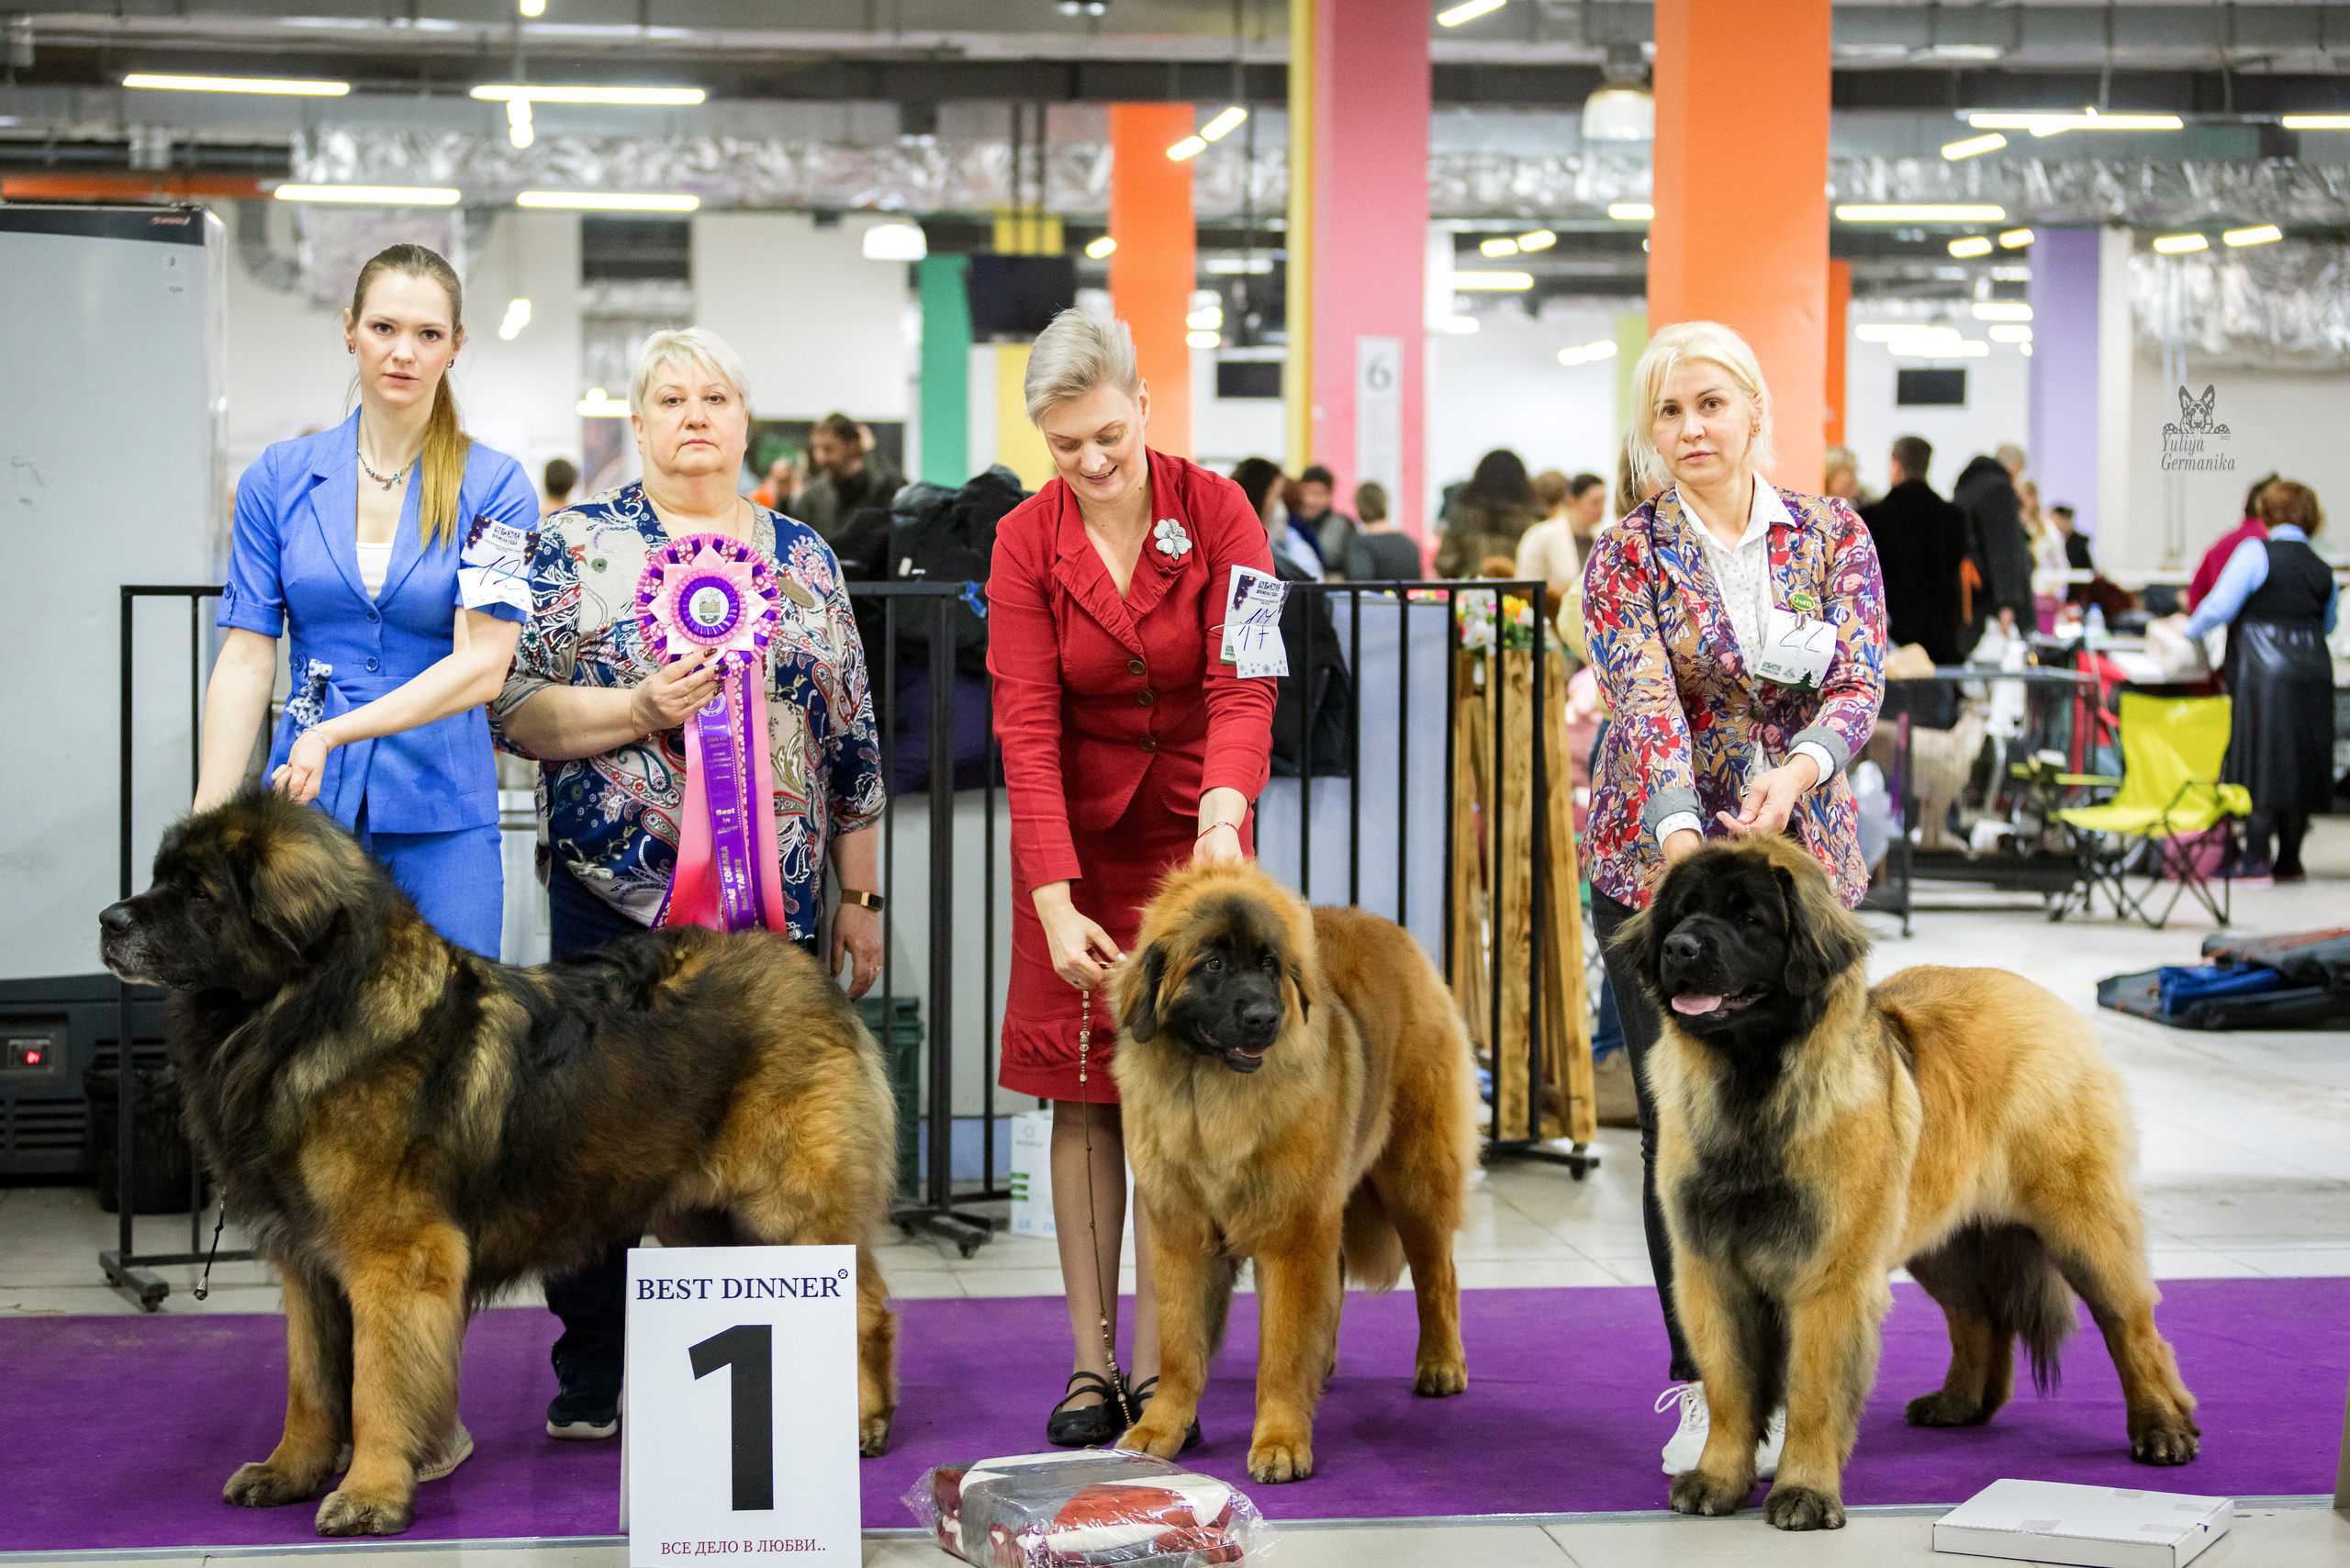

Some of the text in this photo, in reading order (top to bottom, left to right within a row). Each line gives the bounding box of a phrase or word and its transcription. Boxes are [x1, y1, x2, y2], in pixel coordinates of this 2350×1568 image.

[1367, 351, 1392, 392] 6
[1238, 608, 1277, 651] 17
[716, 807, 735, 816] Best
[717, 825, 738, 834] show
[636, 1276, 842, 1300] BEST DINNER
[688, 1324, 774, 1511] 1
[661, 1539, 826, 1557] ВСЕ ДЕЛО В ЛЮБВИ..
